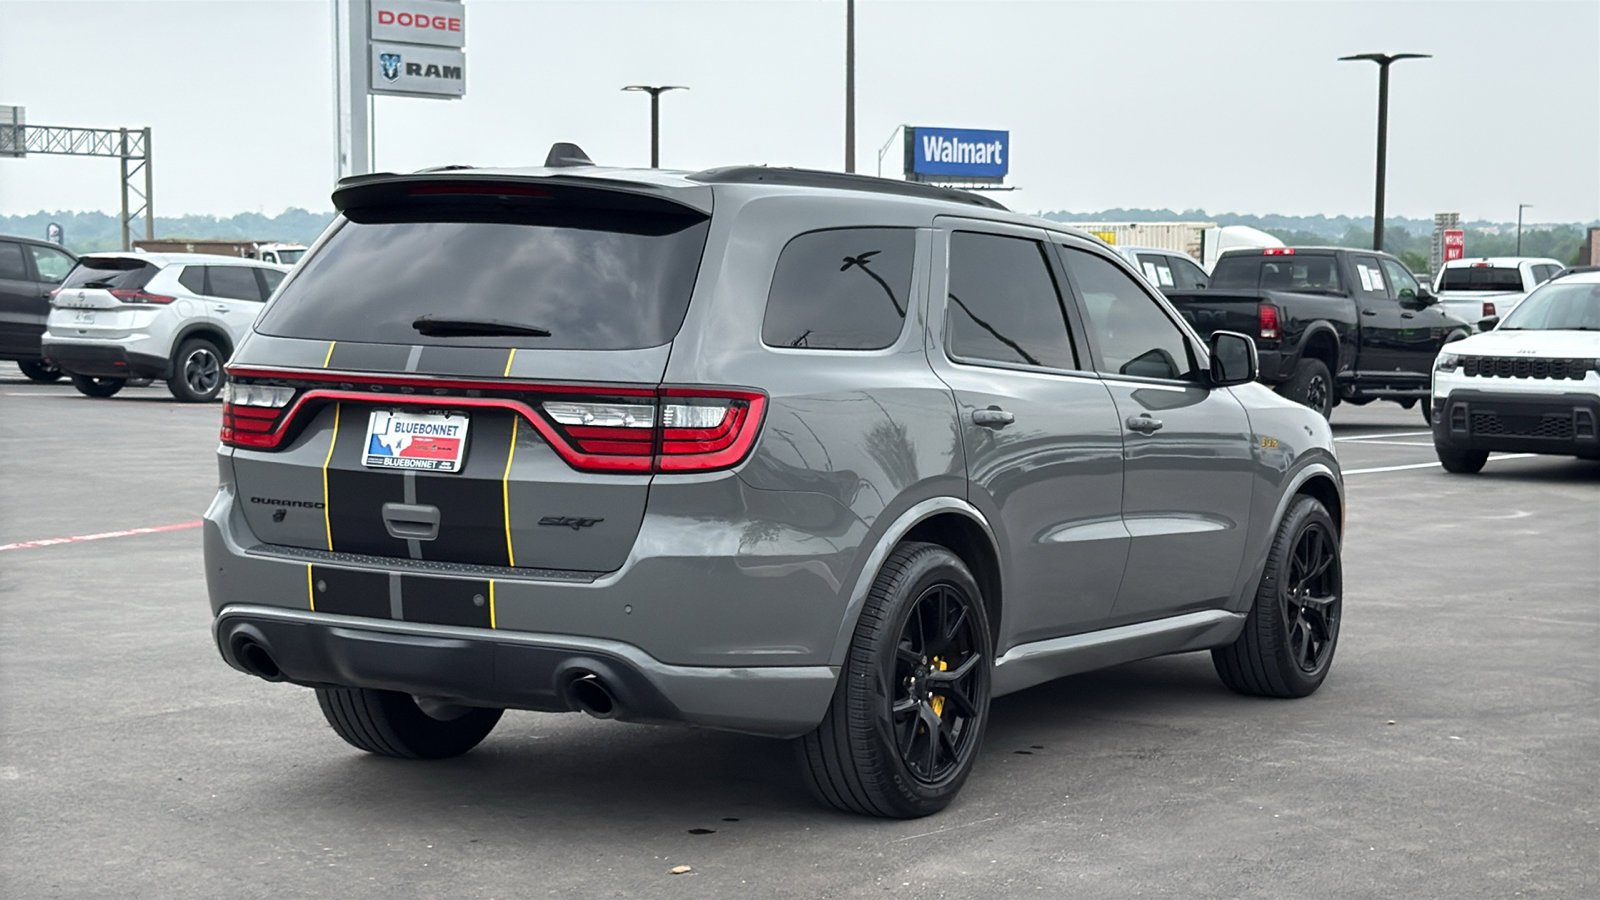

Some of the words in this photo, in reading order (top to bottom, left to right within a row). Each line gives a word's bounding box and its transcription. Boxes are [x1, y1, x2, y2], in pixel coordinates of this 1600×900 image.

[378, 11, 461, 32] DODGE
[406, 62, 461, 80] RAM
[923, 136, 1002, 165] Walmart
[394, 422, 460, 436] BLUEBONNET
[383, 457, 438, 469] BLUEBONNET
[250, 496, 326, 509] DURANGO
[537, 516, 605, 531] SRT
